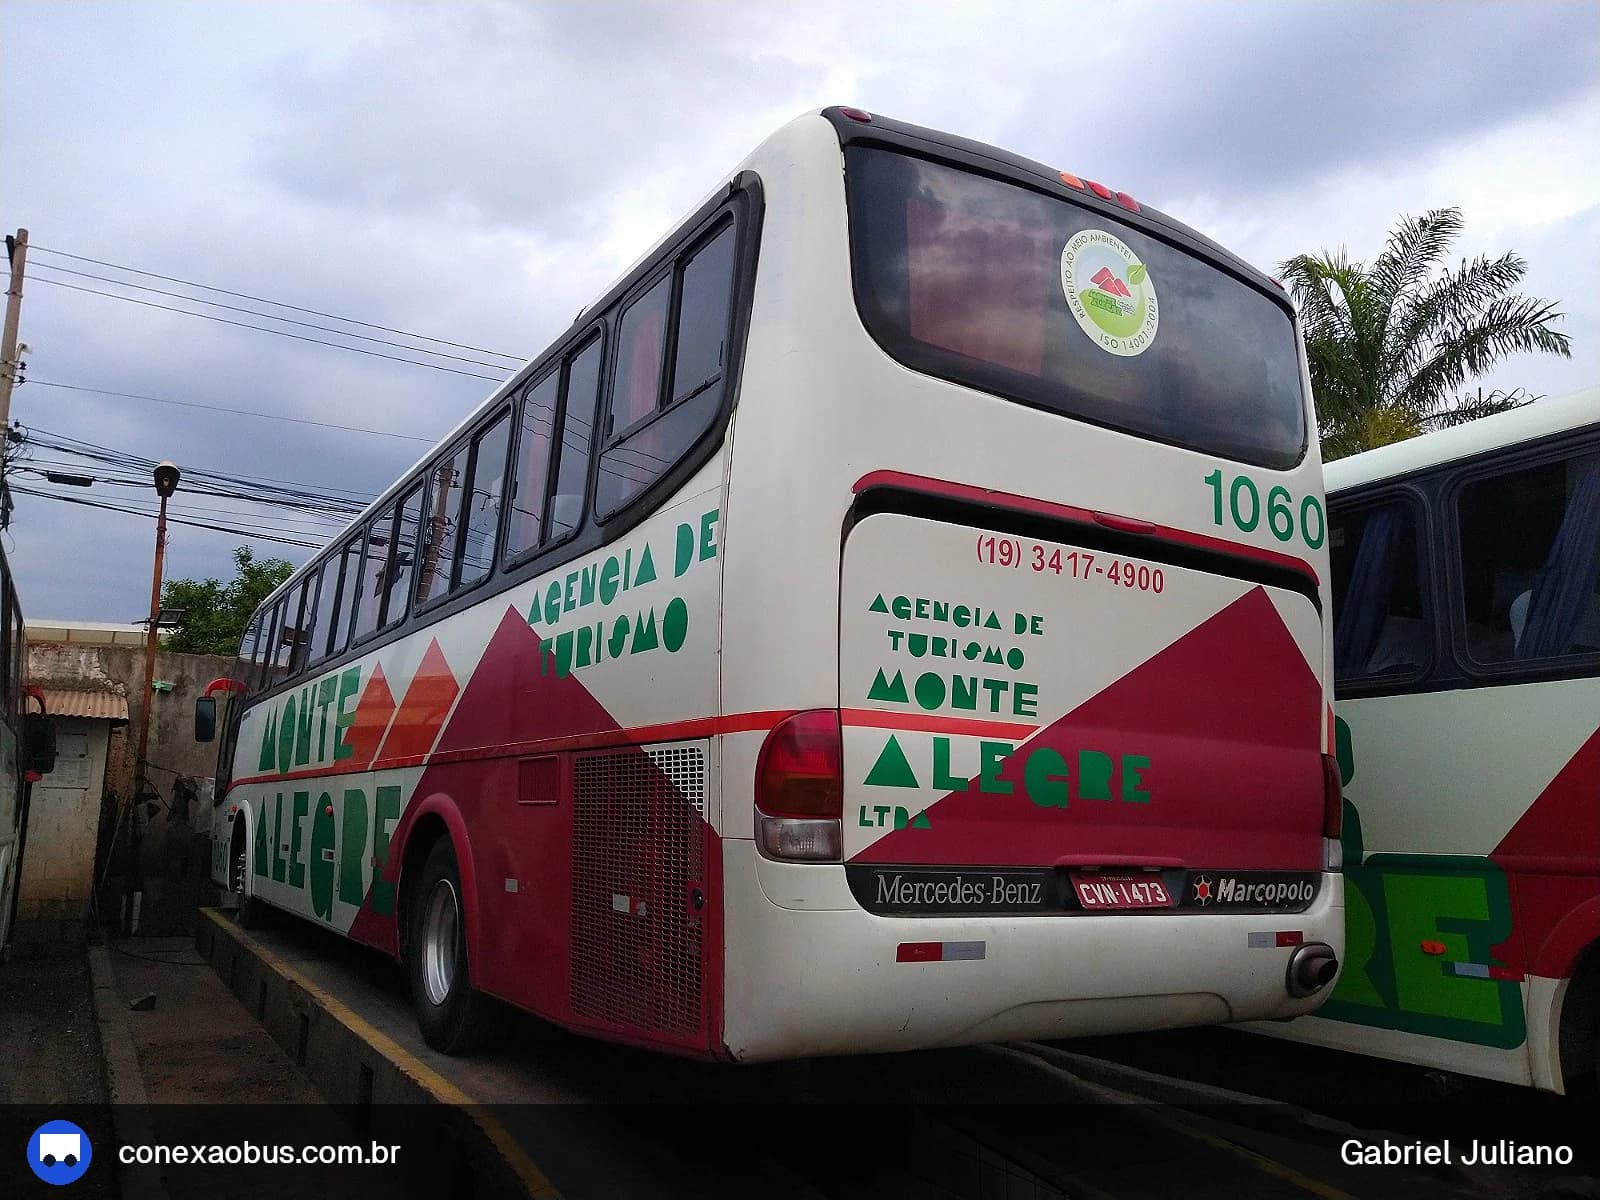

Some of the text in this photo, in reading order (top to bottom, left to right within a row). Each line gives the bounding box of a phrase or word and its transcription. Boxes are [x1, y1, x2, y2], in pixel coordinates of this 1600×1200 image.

[1071, 235, 1088, 253] MEIO
[1065, 270, 1085, 319] RESPEITO
[1100, 332, 1119, 349] ISO
[1122, 297, 1155, 351] 14001:2004
[1204, 469, 1325, 550] 1060
[528, 508, 720, 626] AGENCIA DE
[977, 534, 1164, 594] (19) 3417-4900
[539, 597, 689, 679] TURISMO
[868, 593, 1044, 635] AGENCIA DE
[887, 630, 1025, 670] TURISMO
[866, 666, 1039, 717] MONTE
[259, 665, 362, 775] MONTE
[863, 733, 1151, 809] ALEGRE
[859, 805, 932, 830] LTDA
[255, 785, 402, 922] ALEGRE
[875, 874, 1042, 905] Mercedes-Benz
[1216, 878, 1314, 903] Marcopolo
